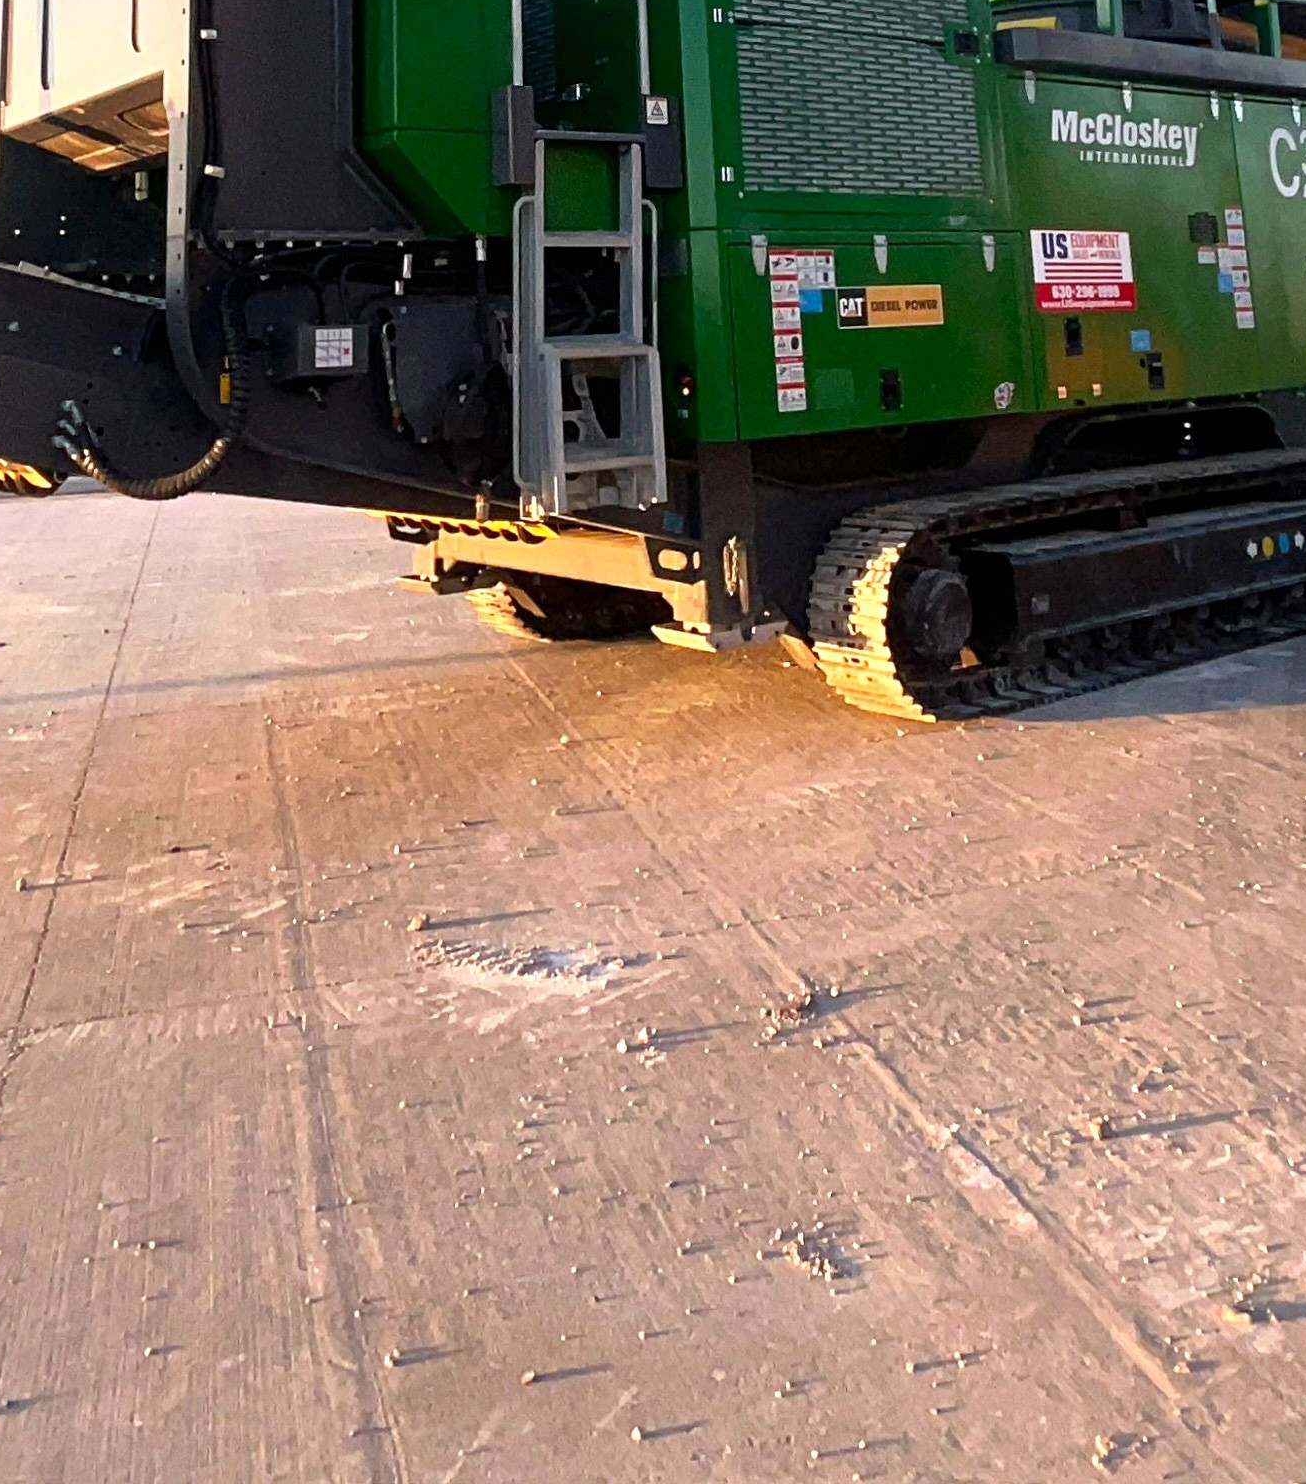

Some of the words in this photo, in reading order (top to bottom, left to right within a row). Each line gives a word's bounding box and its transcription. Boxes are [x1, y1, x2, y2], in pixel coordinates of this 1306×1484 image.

[1051, 109, 1198, 167] McCloskey
[1079, 150, 1185, 167] INTERNATIONAL
[1040, 232, 1069, 260] US
[1070, 233, 1120, 248] EQUIPMENT
[839, 297, 865, 318] CAT
[870, 300, 902, 312] DIESEL
[904, 299, 939, 311] POWER
